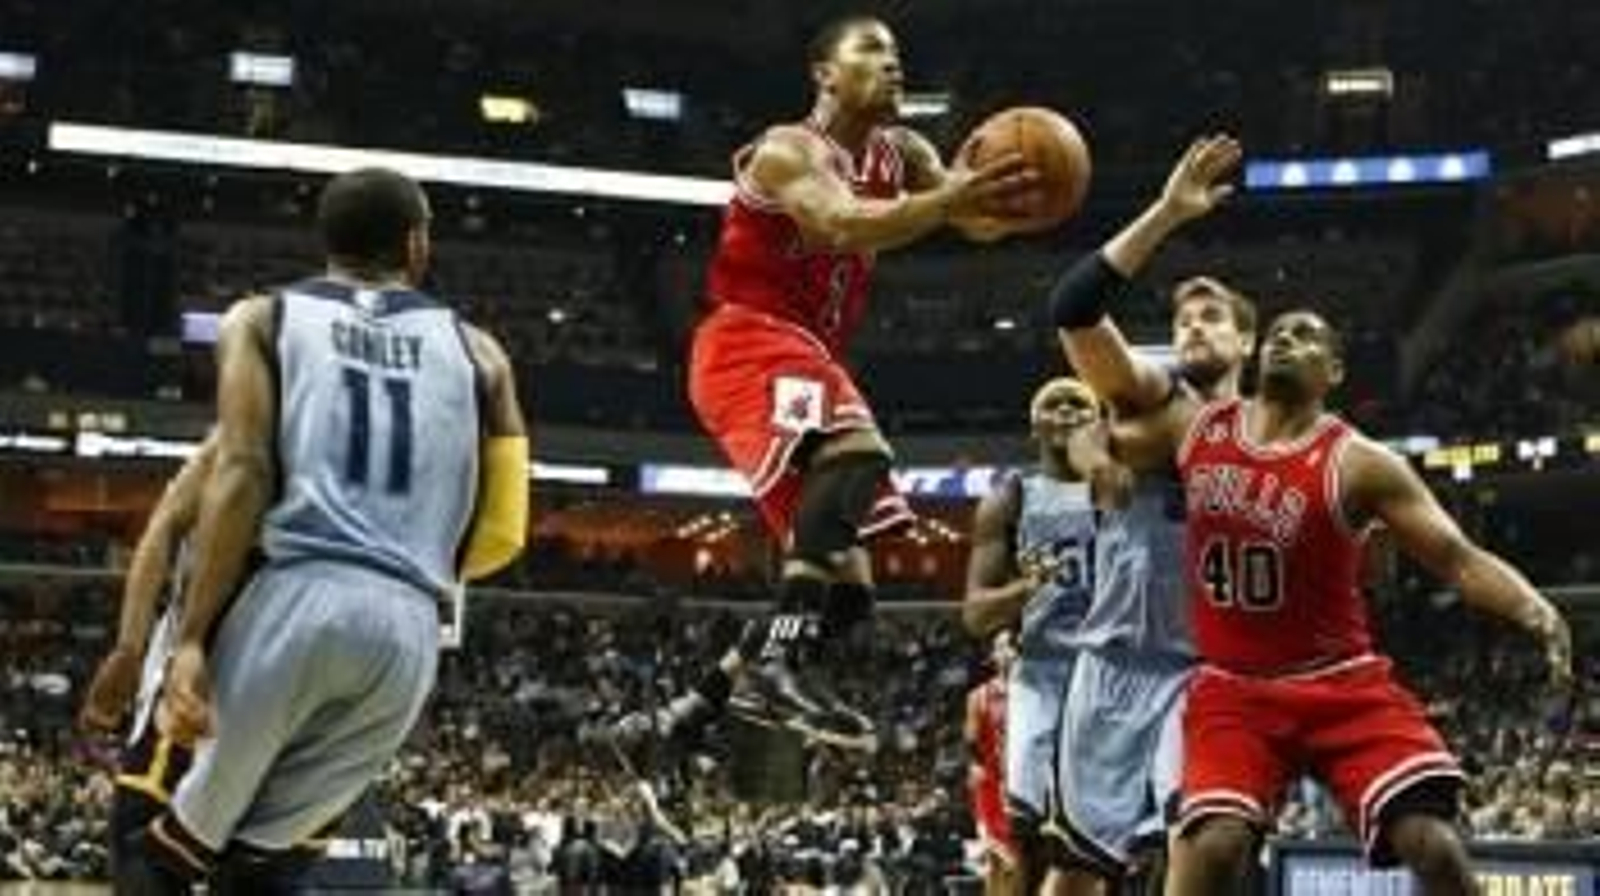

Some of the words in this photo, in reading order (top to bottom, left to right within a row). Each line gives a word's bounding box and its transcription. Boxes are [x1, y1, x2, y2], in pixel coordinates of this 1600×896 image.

[331, 319, 423, 370] CONLEY
[343, 366, 411, 497] 11
[1199, 535, 1284, 611] 40
